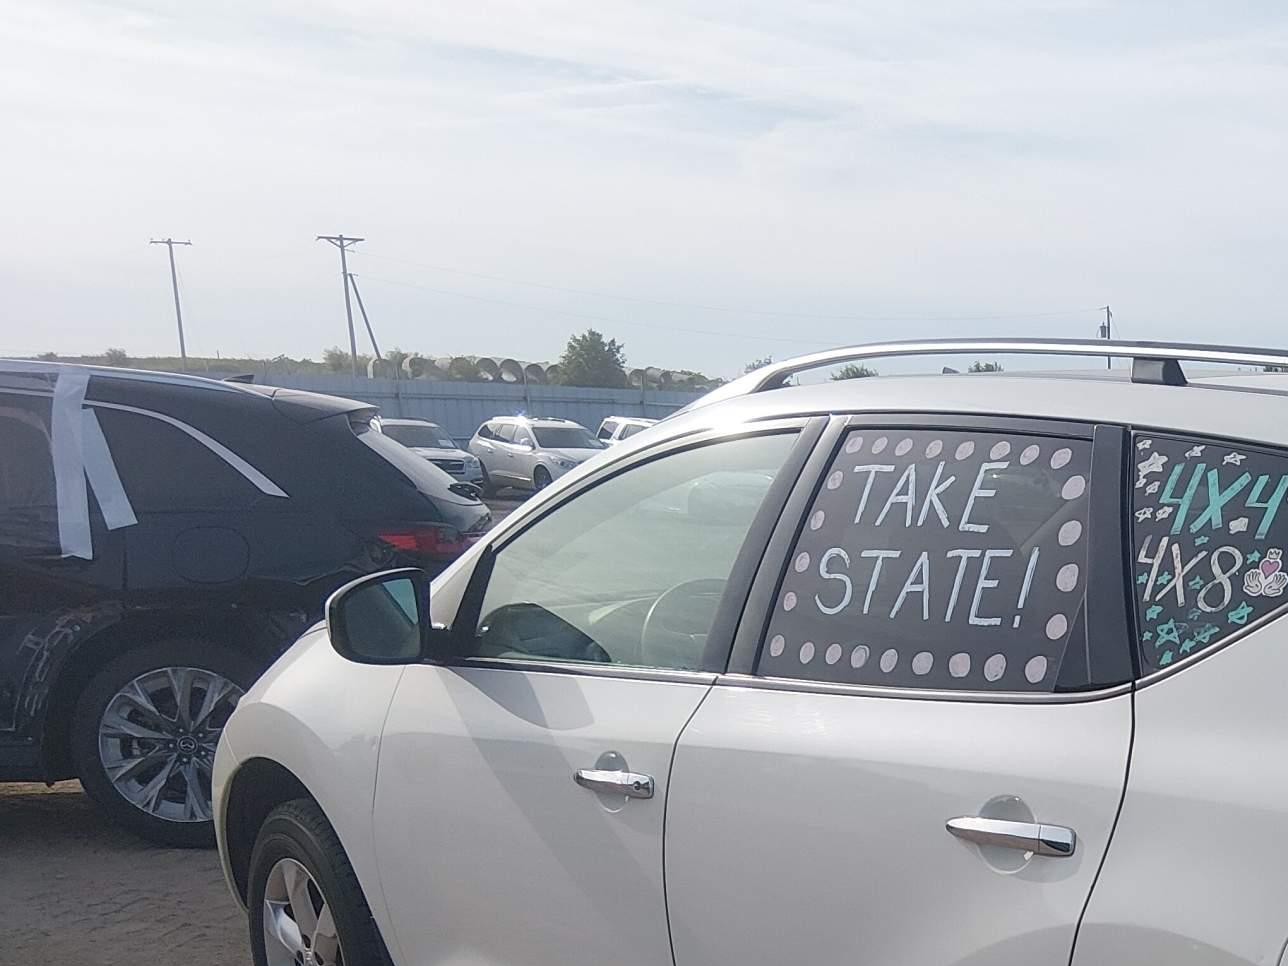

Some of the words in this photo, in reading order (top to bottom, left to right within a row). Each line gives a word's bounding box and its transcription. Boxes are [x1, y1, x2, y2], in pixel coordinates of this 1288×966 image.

[853, 461, 1010, 533] TAKE
[815, 547, 1040, 628] STATE!
[1137, 535, 1243, 612] 4X8
